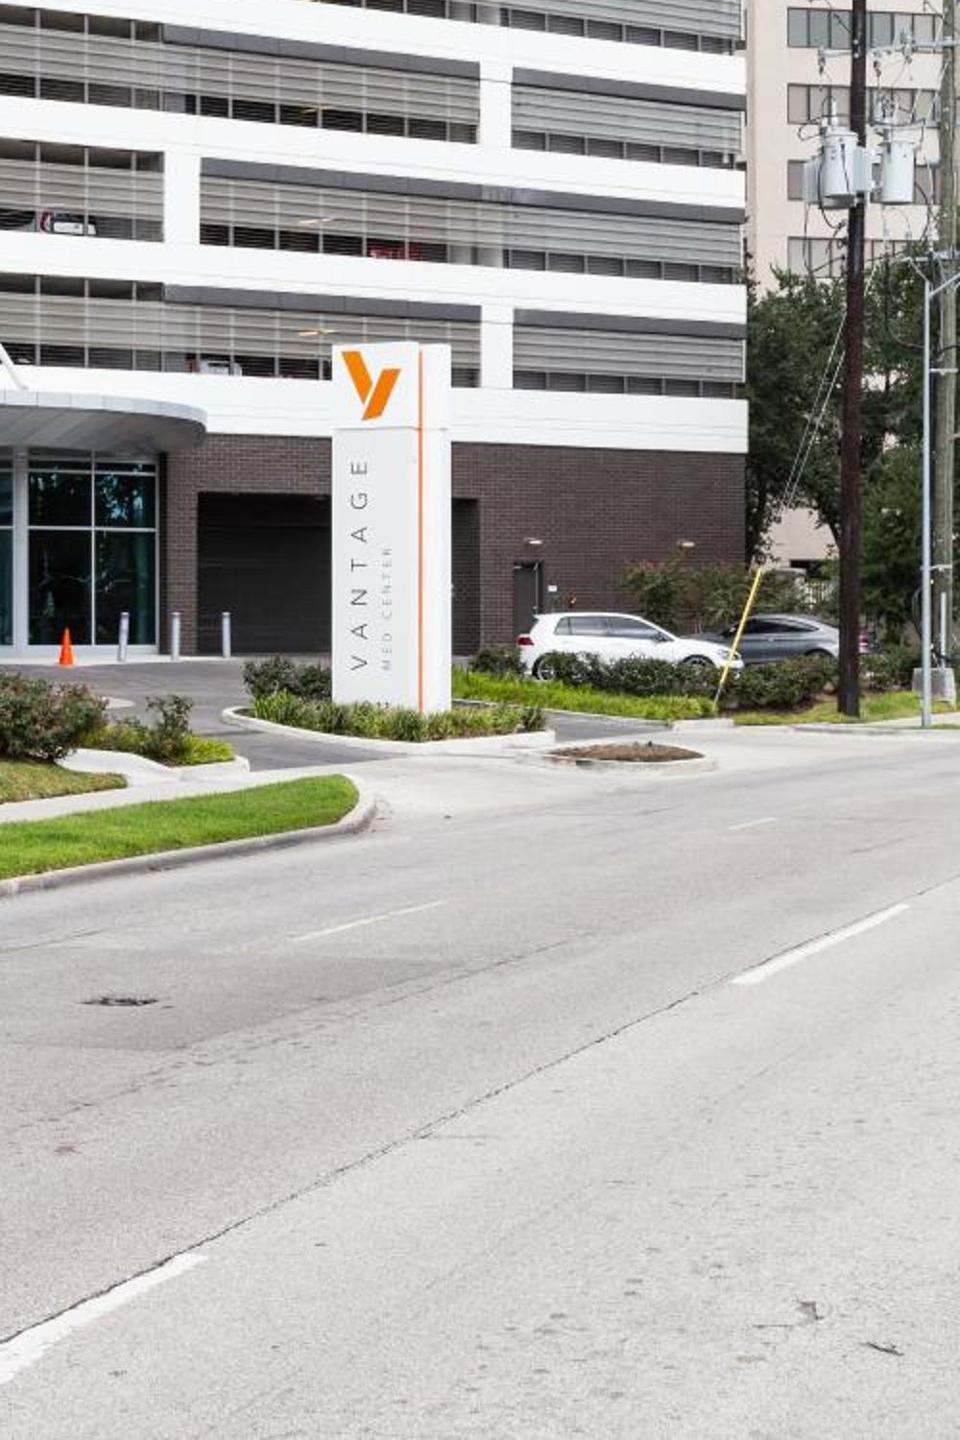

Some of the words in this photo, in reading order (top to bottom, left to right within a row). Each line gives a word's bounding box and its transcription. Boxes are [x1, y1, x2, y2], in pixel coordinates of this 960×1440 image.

[350, 460, 368, 671] VANTAGE
[381, 548, 392, 620] CENTER
[381, 633, 392, 671] MED
